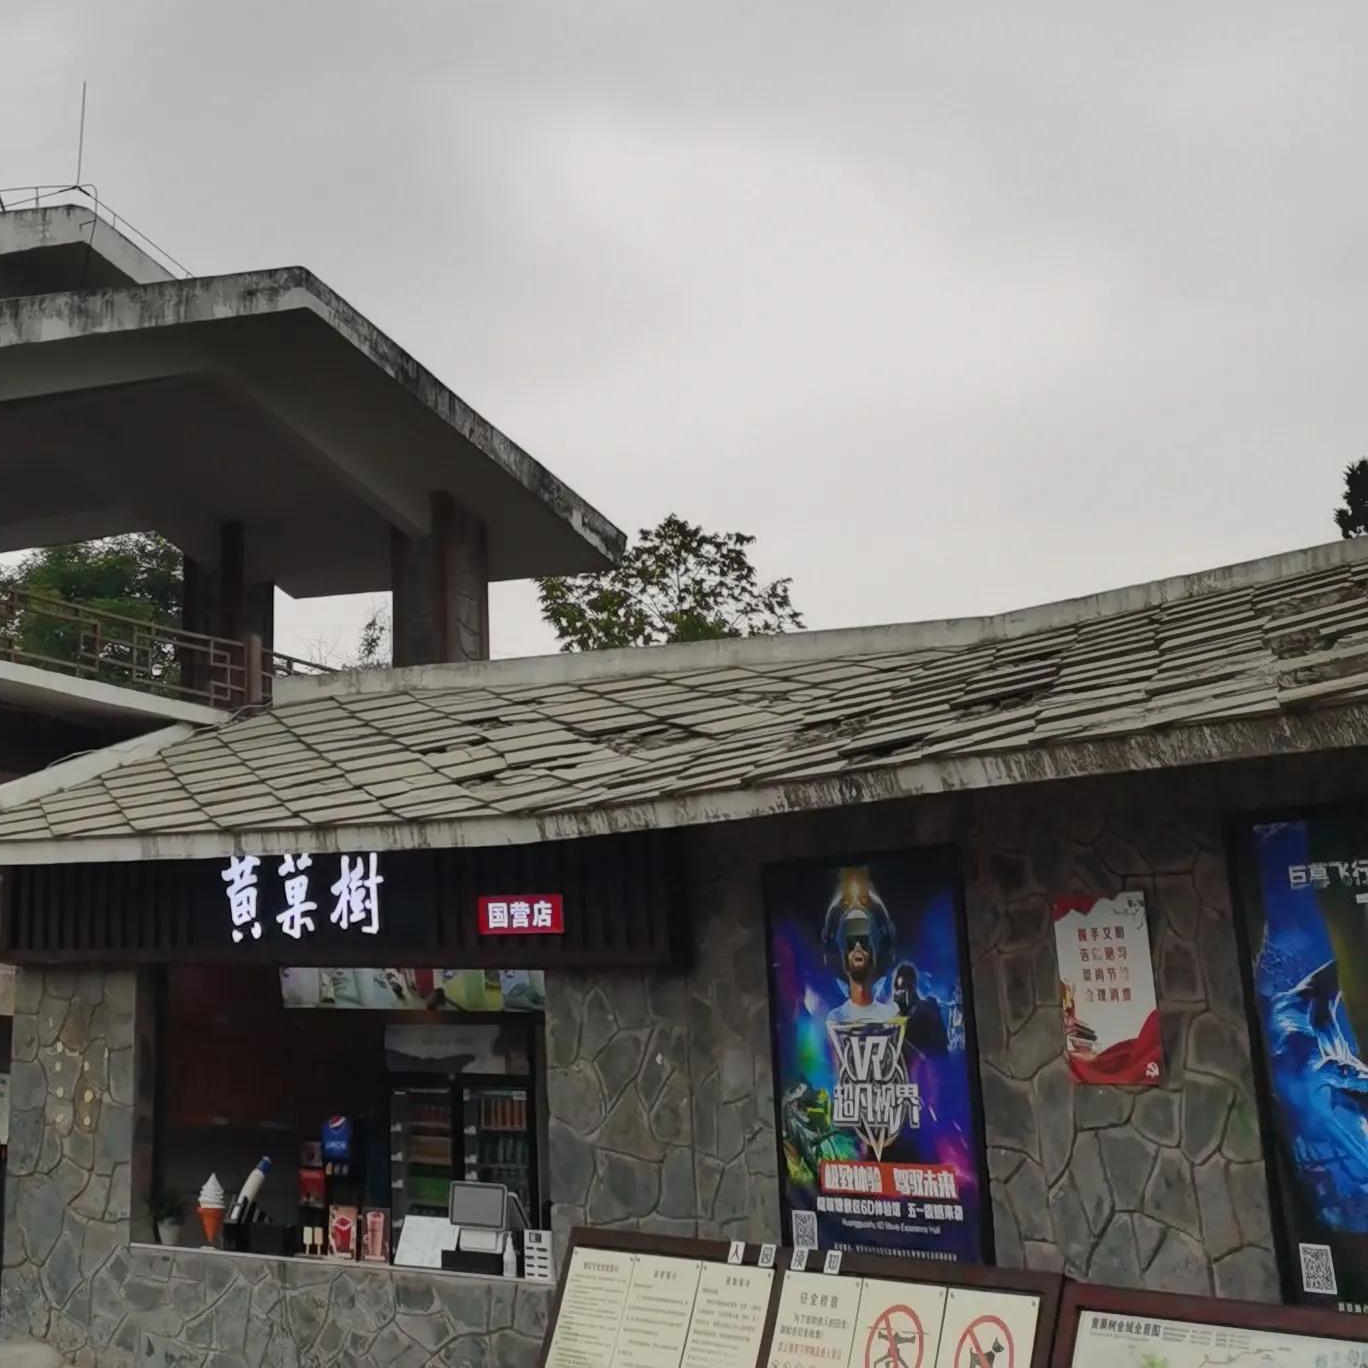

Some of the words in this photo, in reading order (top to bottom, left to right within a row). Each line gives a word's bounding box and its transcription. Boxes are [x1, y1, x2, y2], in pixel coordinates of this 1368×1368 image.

[486, 900, 553, 929] 国营店
[848, 1035, 889, 1081] VR
[833, 1083, 922, 1136] 超凡视界
